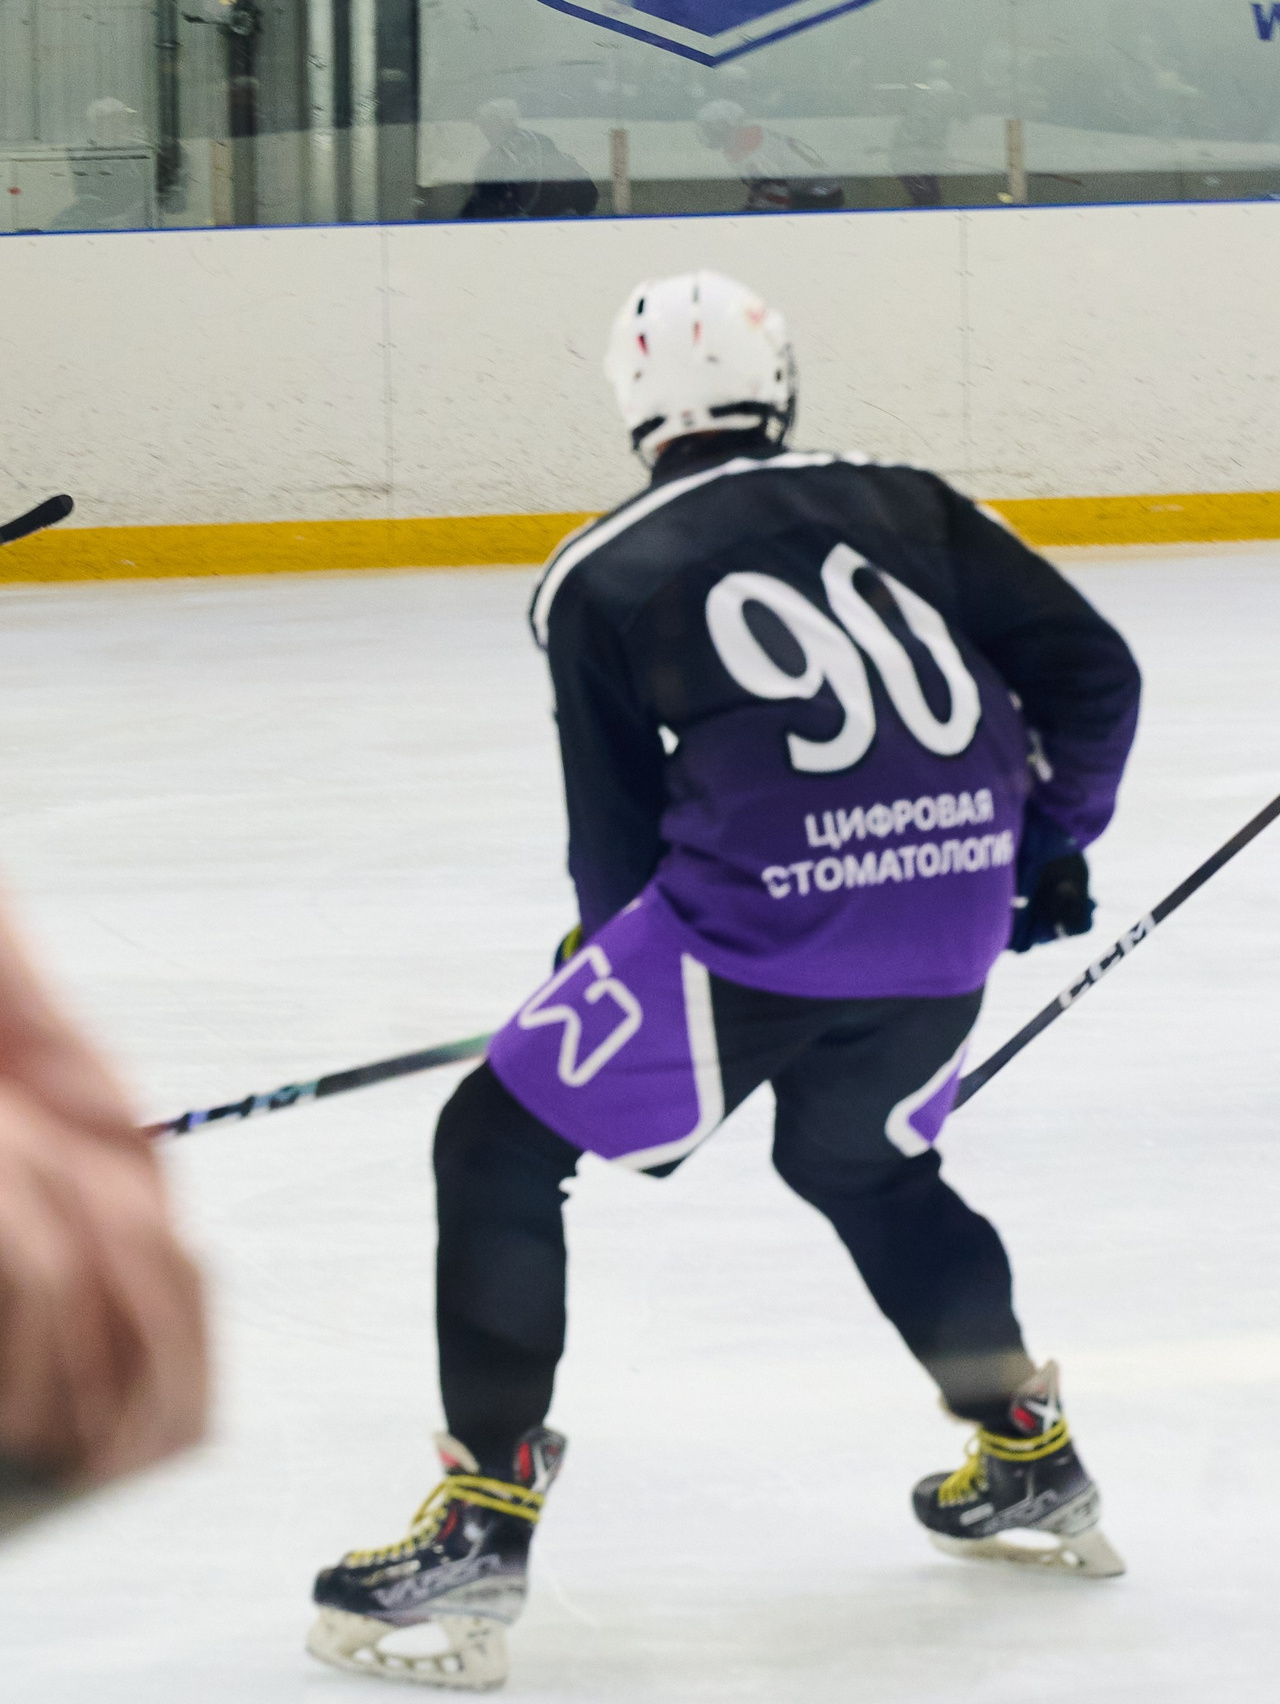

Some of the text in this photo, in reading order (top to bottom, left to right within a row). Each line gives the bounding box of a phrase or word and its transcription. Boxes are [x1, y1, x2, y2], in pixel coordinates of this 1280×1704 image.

[705, 542, 982, 773] 90
[805, 787, 995, 851] ЦИФРОВАЯ
[761, 829, 1014, 900] СТОМАТОЛОГИ
[1058, 911, 1156, 1010] CCM
